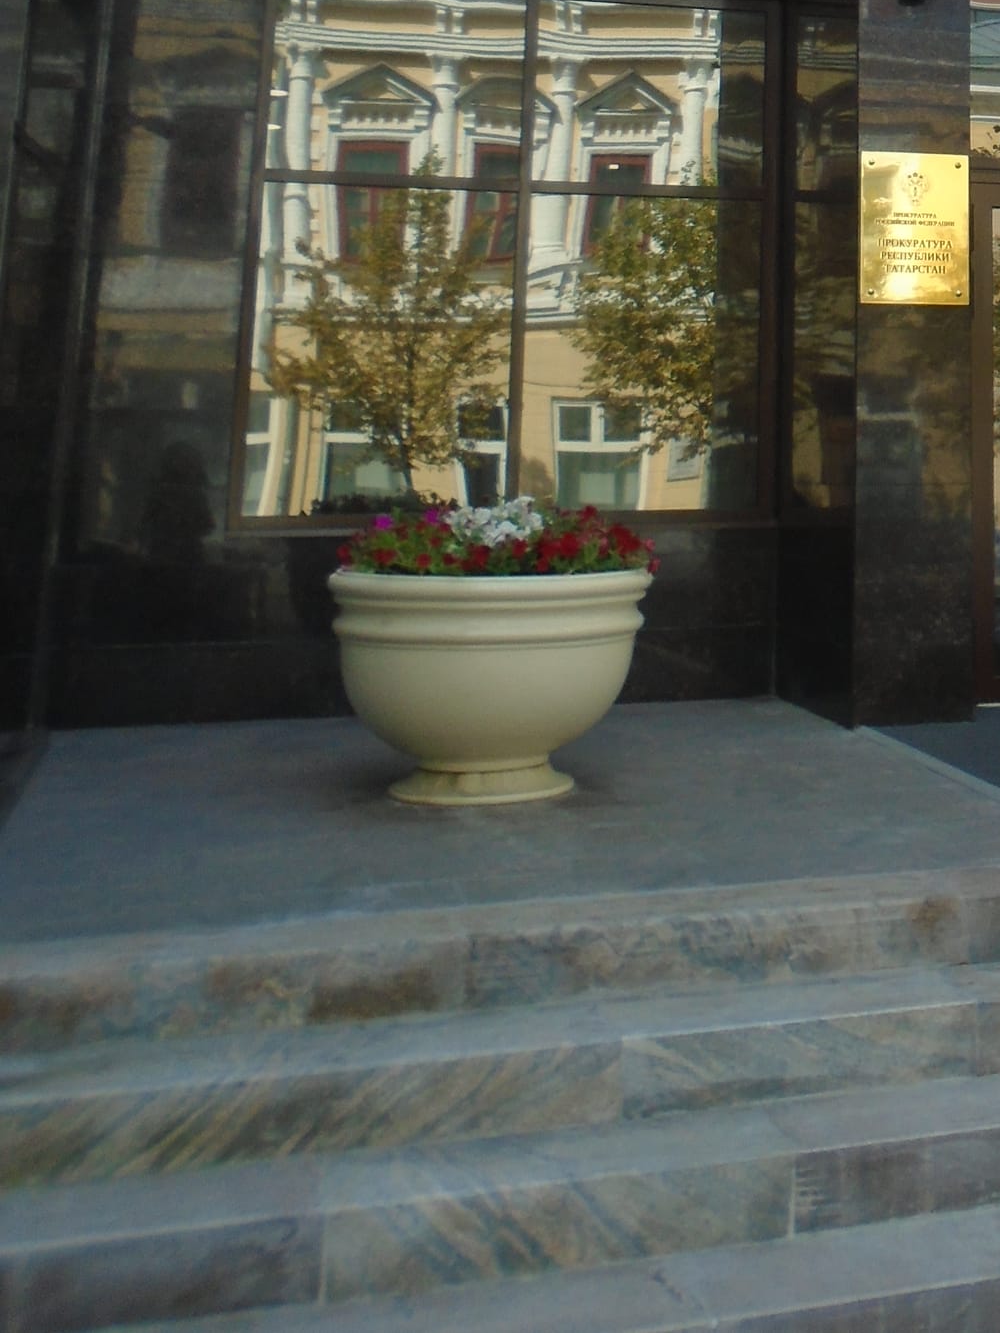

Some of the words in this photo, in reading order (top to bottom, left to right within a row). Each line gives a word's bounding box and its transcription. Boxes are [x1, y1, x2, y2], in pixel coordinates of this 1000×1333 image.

[878, 238, 953, 249] ПРОКУРАТУРА
[881, 251, 950, 262] РЕСПУБЛИКИ
[884, 264, 946, 275] ТАТАРСТАН
